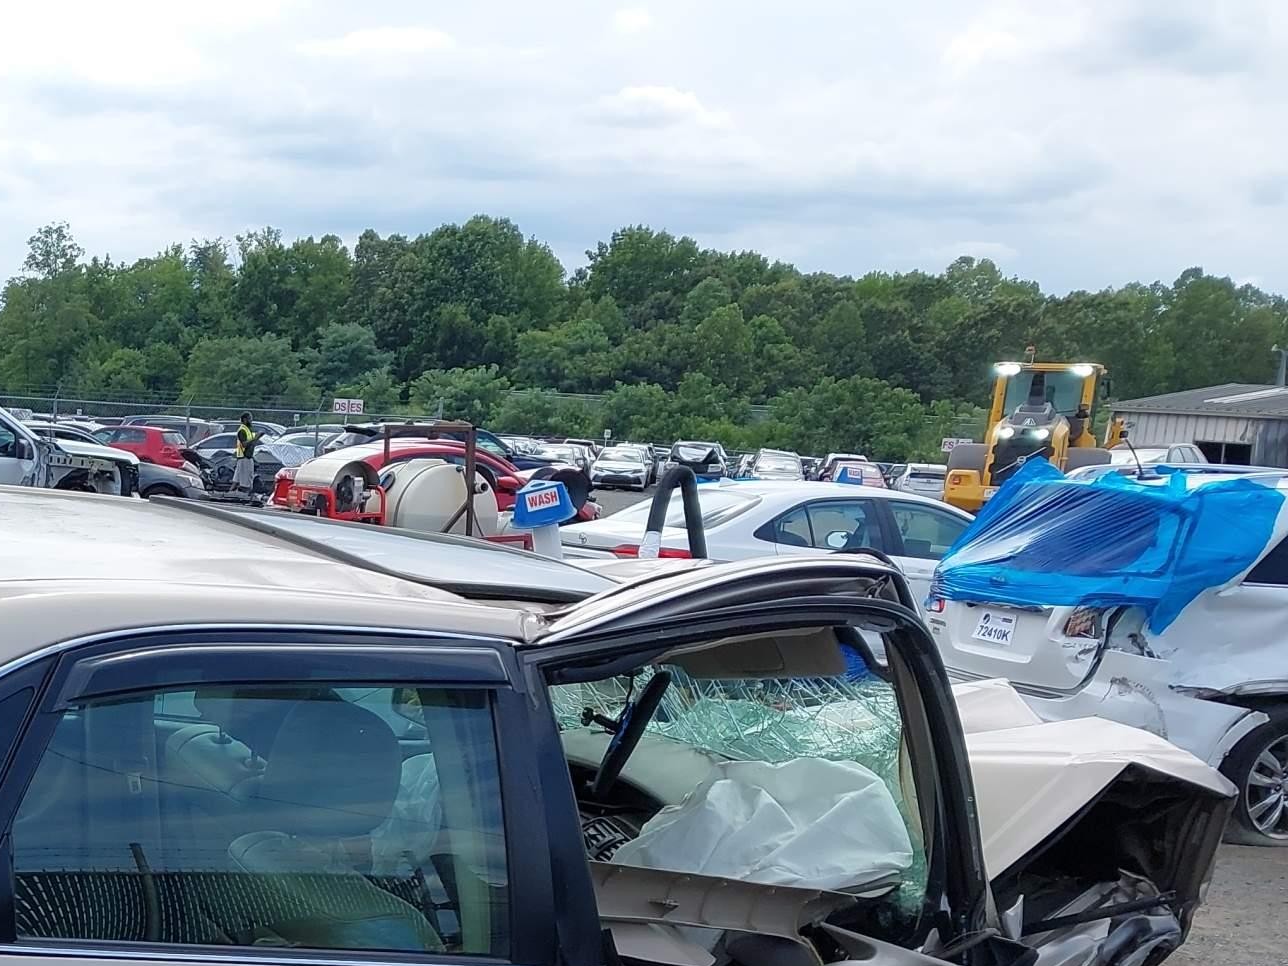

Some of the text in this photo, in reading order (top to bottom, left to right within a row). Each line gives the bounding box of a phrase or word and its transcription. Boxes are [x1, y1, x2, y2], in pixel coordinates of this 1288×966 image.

[335, 402, 362, 412] DS ES
[528, 490, 558, 508] WASH
[978, 624, 1011, 641] 72410K
